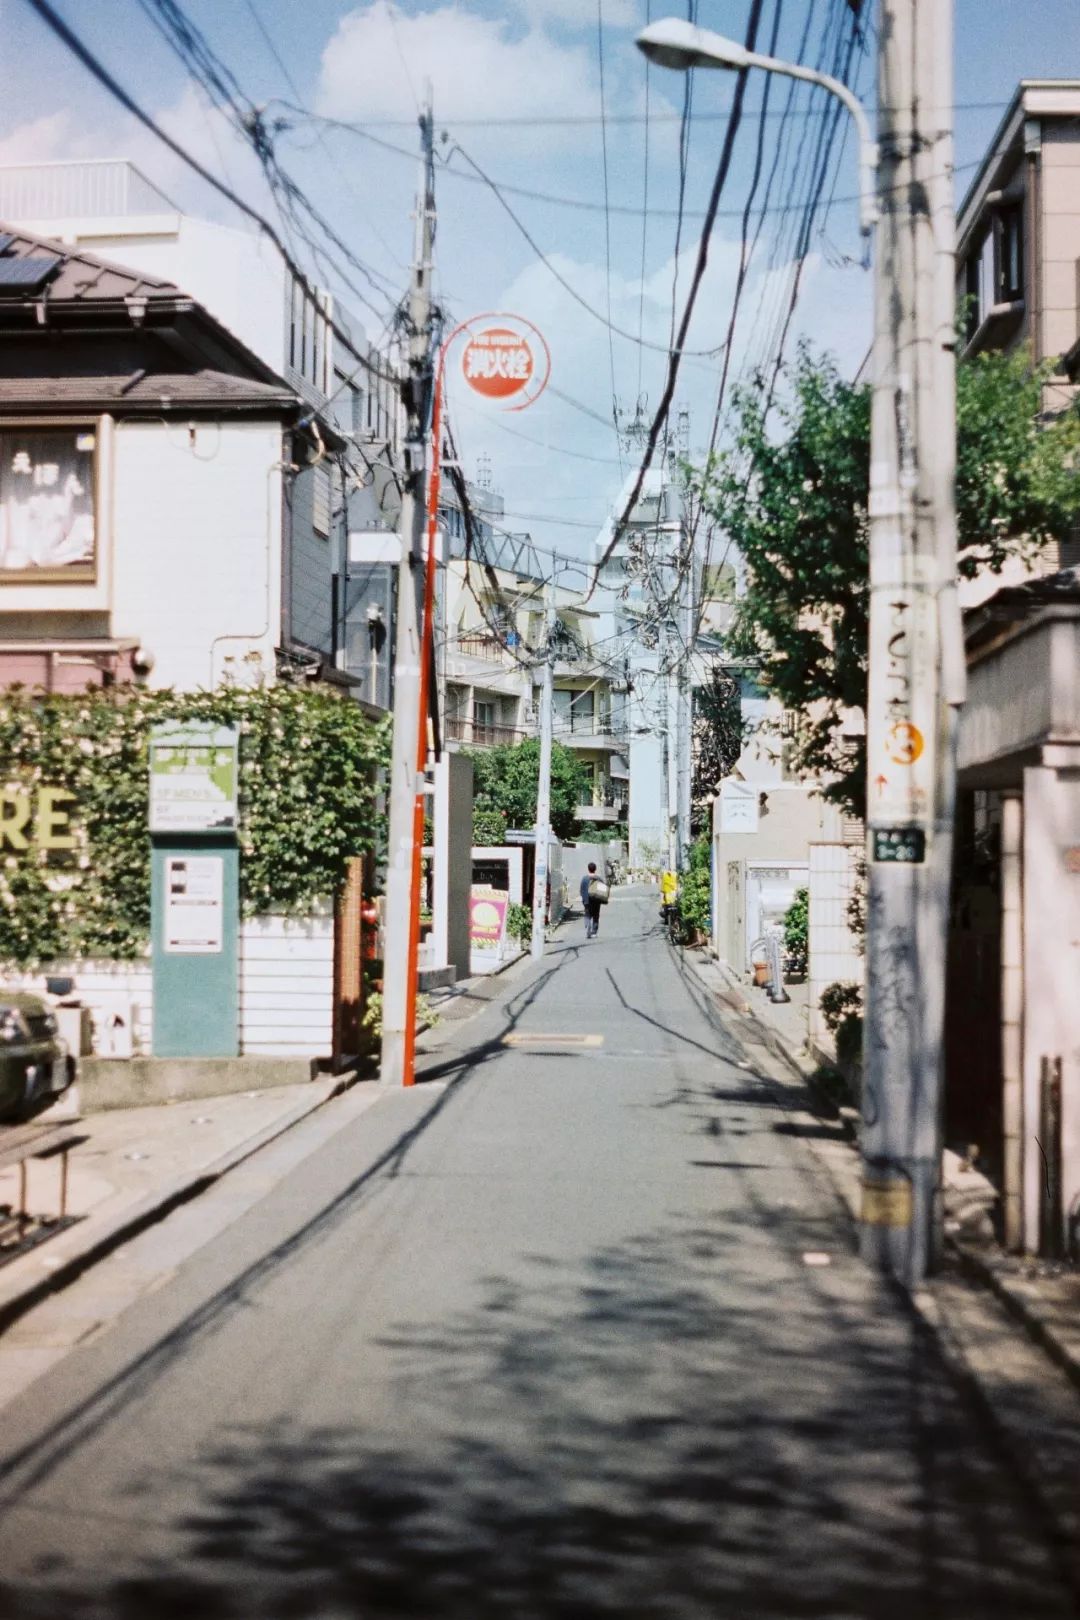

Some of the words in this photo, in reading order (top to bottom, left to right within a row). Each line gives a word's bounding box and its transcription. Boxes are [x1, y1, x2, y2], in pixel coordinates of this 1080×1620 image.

[467, 347, 529, 379] 消火栓
[0, 786, 78, 848] RE
